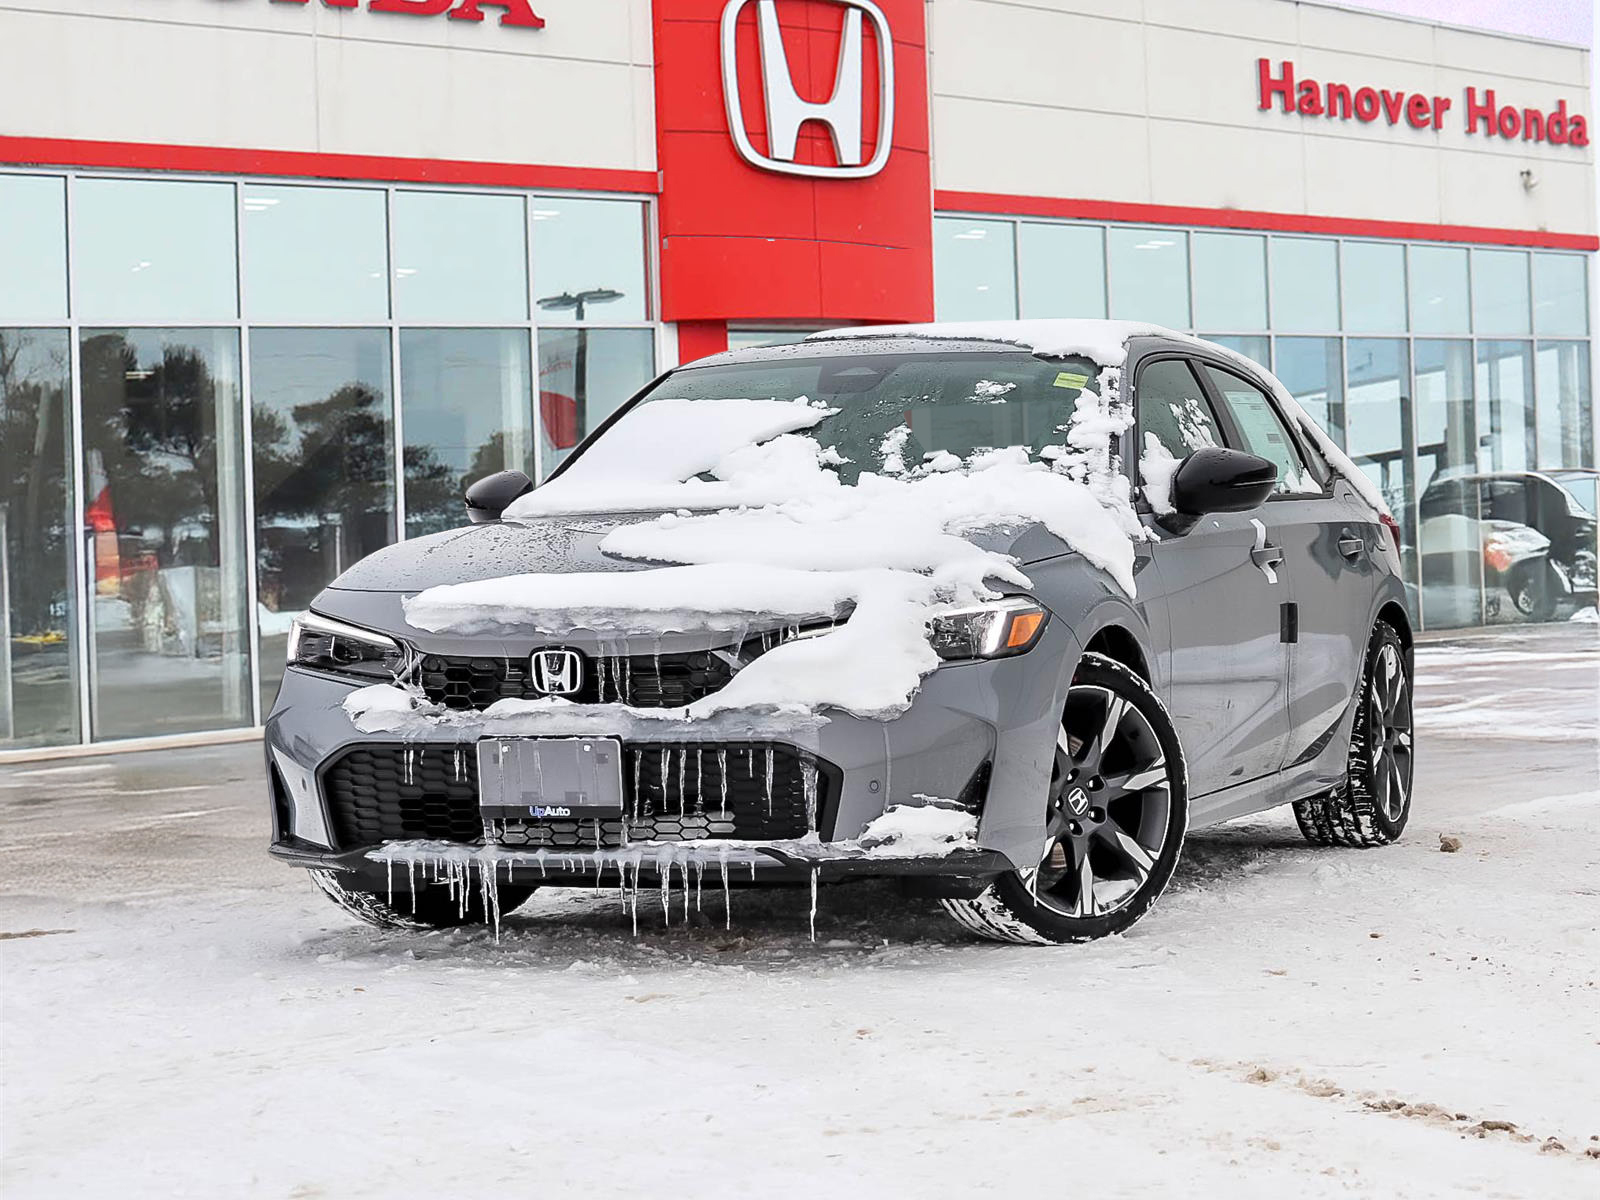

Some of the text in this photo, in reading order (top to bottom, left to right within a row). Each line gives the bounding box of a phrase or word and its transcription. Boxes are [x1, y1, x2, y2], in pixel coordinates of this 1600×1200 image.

[1257, 57, 1590, 147] Hanover Honda
[529, 805, 571, 818] UpAuto
